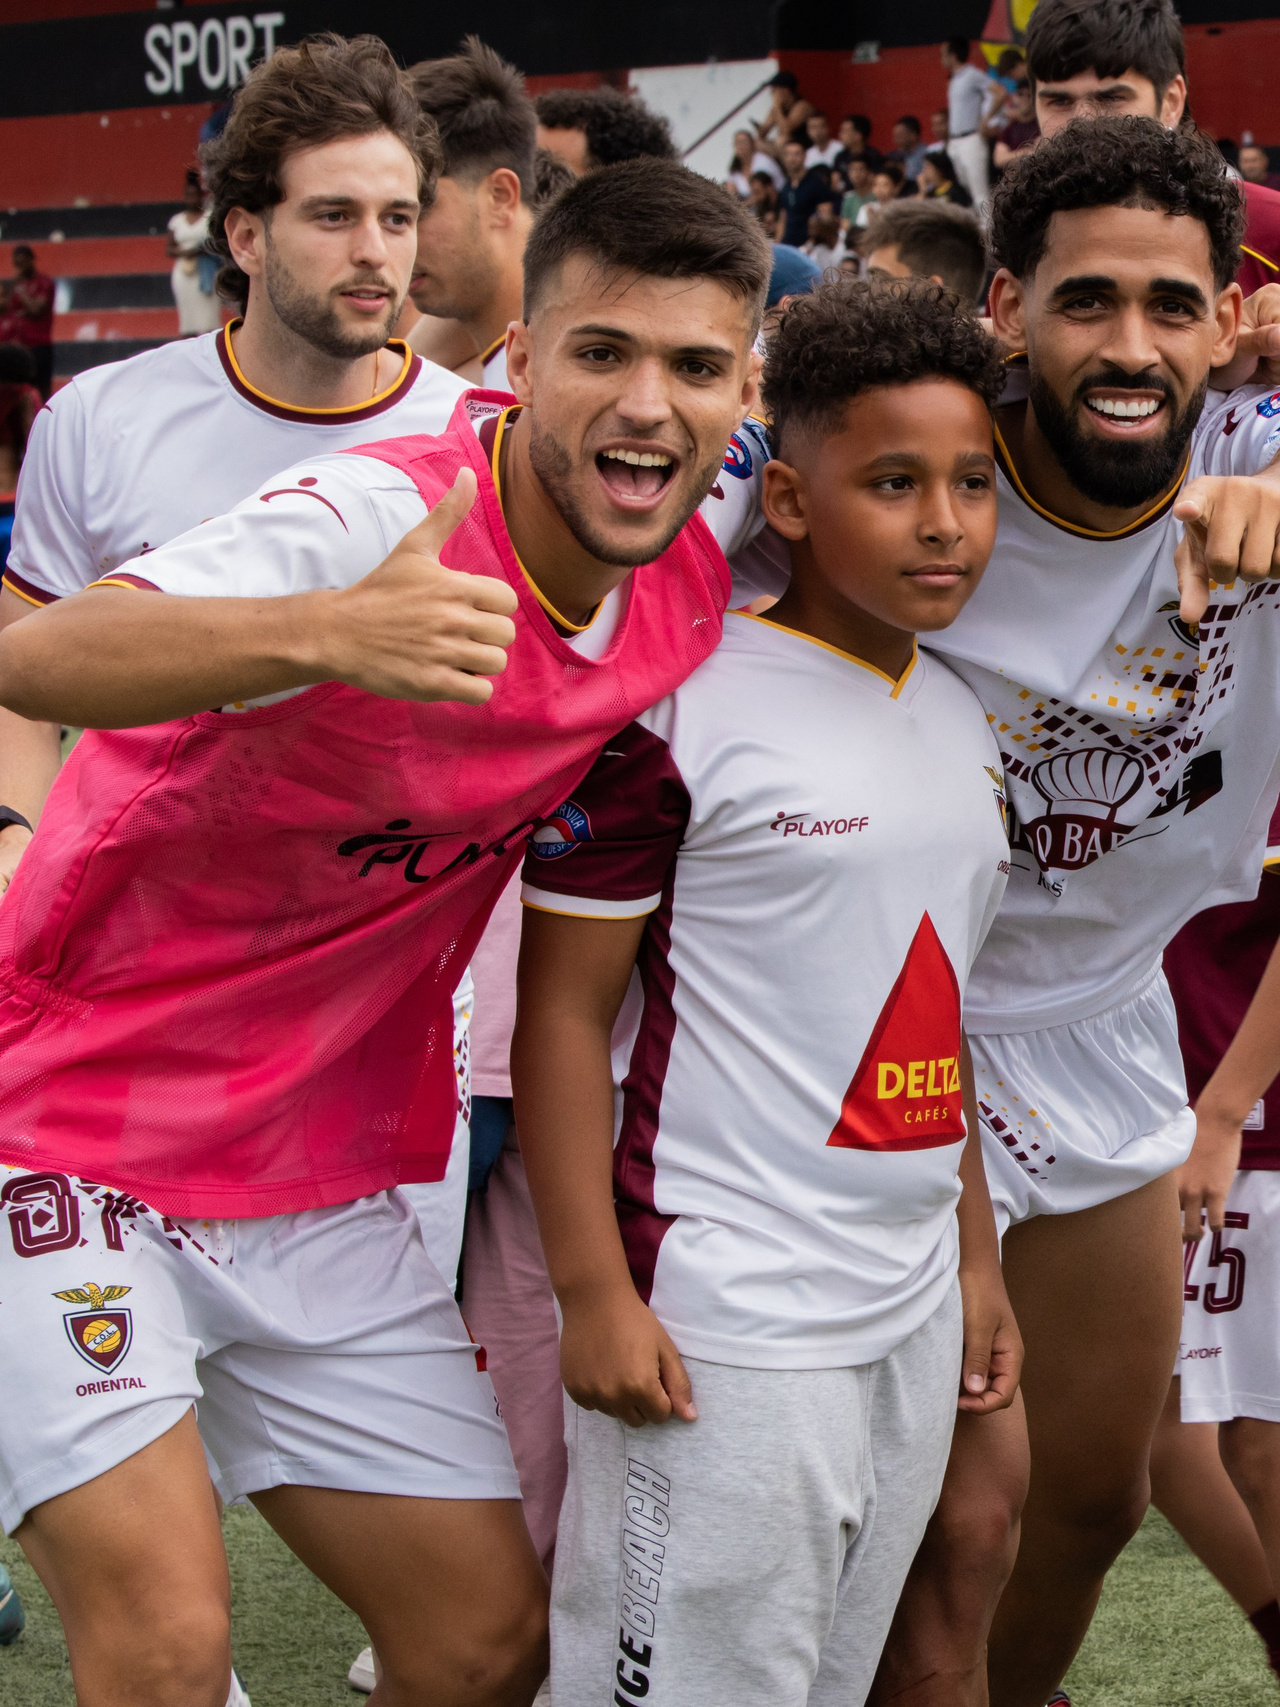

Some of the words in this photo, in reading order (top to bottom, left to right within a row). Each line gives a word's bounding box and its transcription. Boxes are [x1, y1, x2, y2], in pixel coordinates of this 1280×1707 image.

[469, 405, 498, 414] PLAYOFF
[783, 816, 869, 837] PLAYOFF
[877, 1056, 960, 1100] DELTA
[904, 1106, 948, 1123] CAFÉS
[93, 1329, 116, 1345] C.O.L.
[76, 1377, 146, 1397] ORIENTAL
